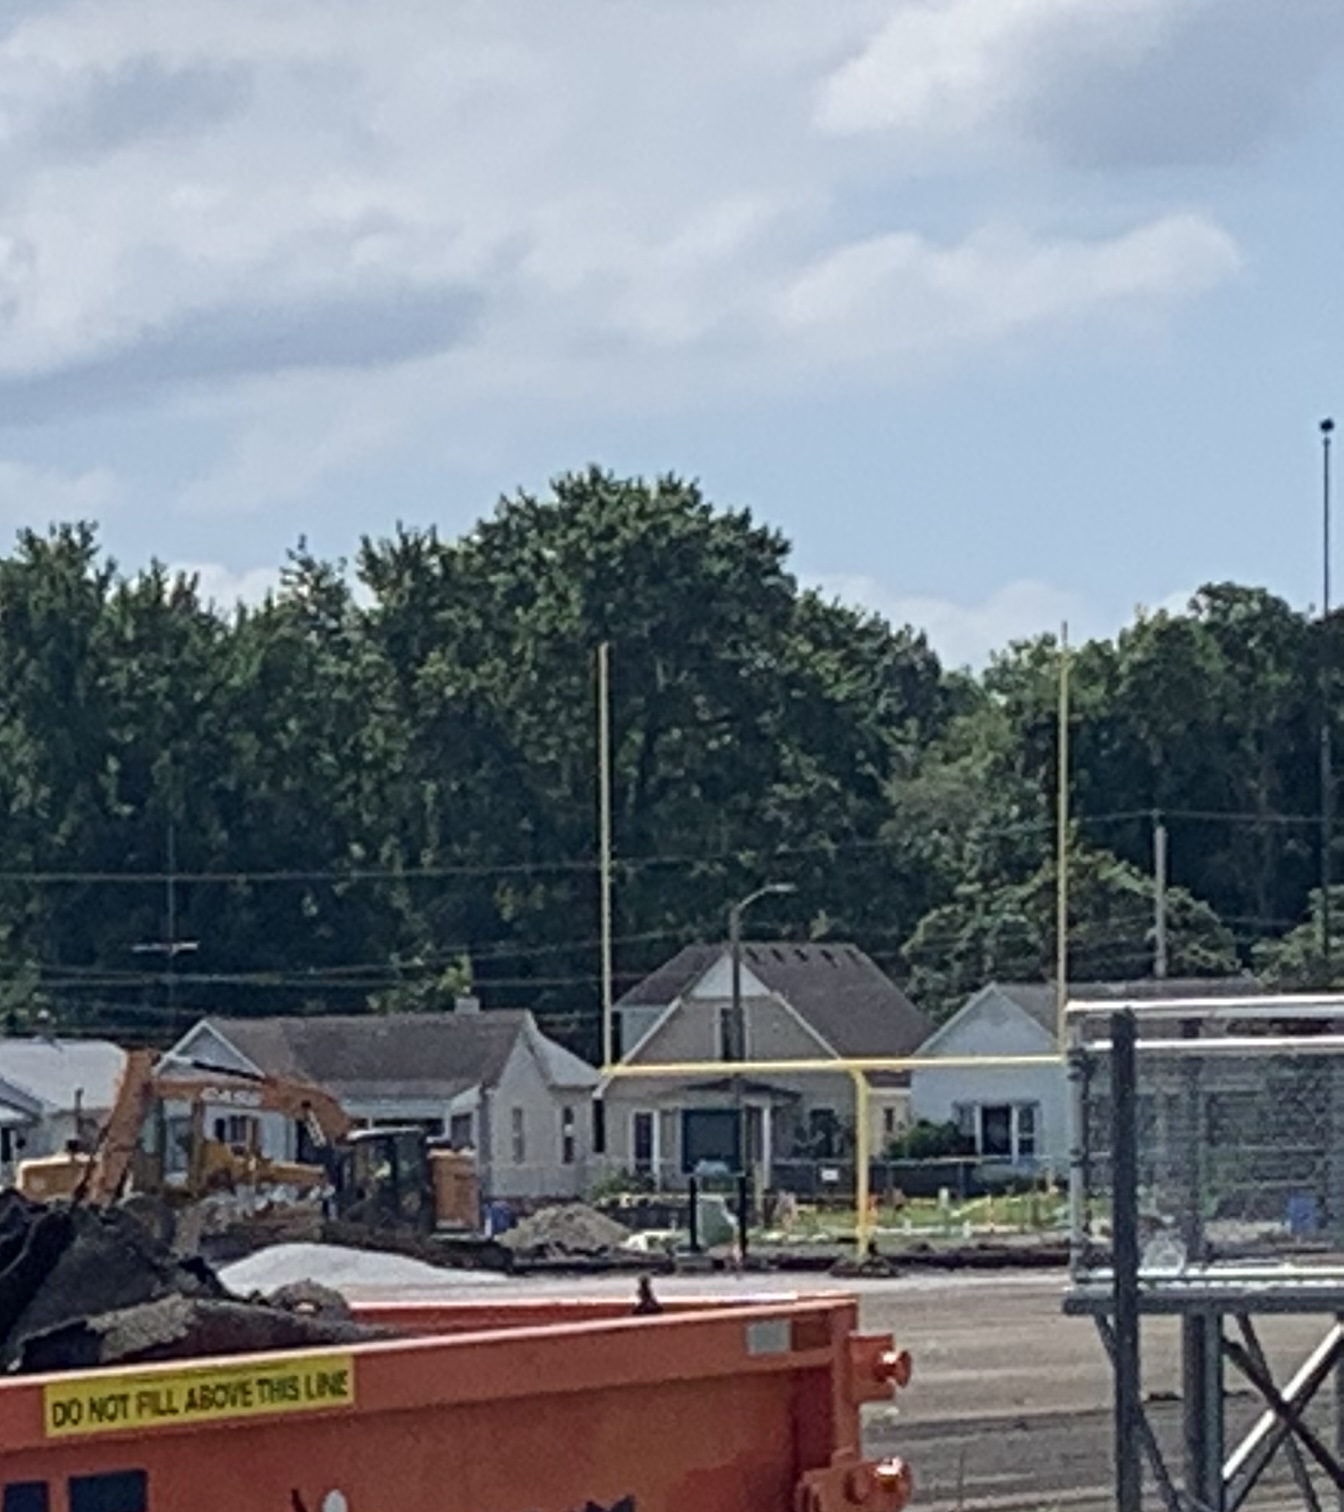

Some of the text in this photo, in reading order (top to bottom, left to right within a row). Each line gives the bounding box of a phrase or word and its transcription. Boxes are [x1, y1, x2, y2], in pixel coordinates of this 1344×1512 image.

[52, 1369, 349, 1427] DO NOT FILL ABOVE THIS LINE
